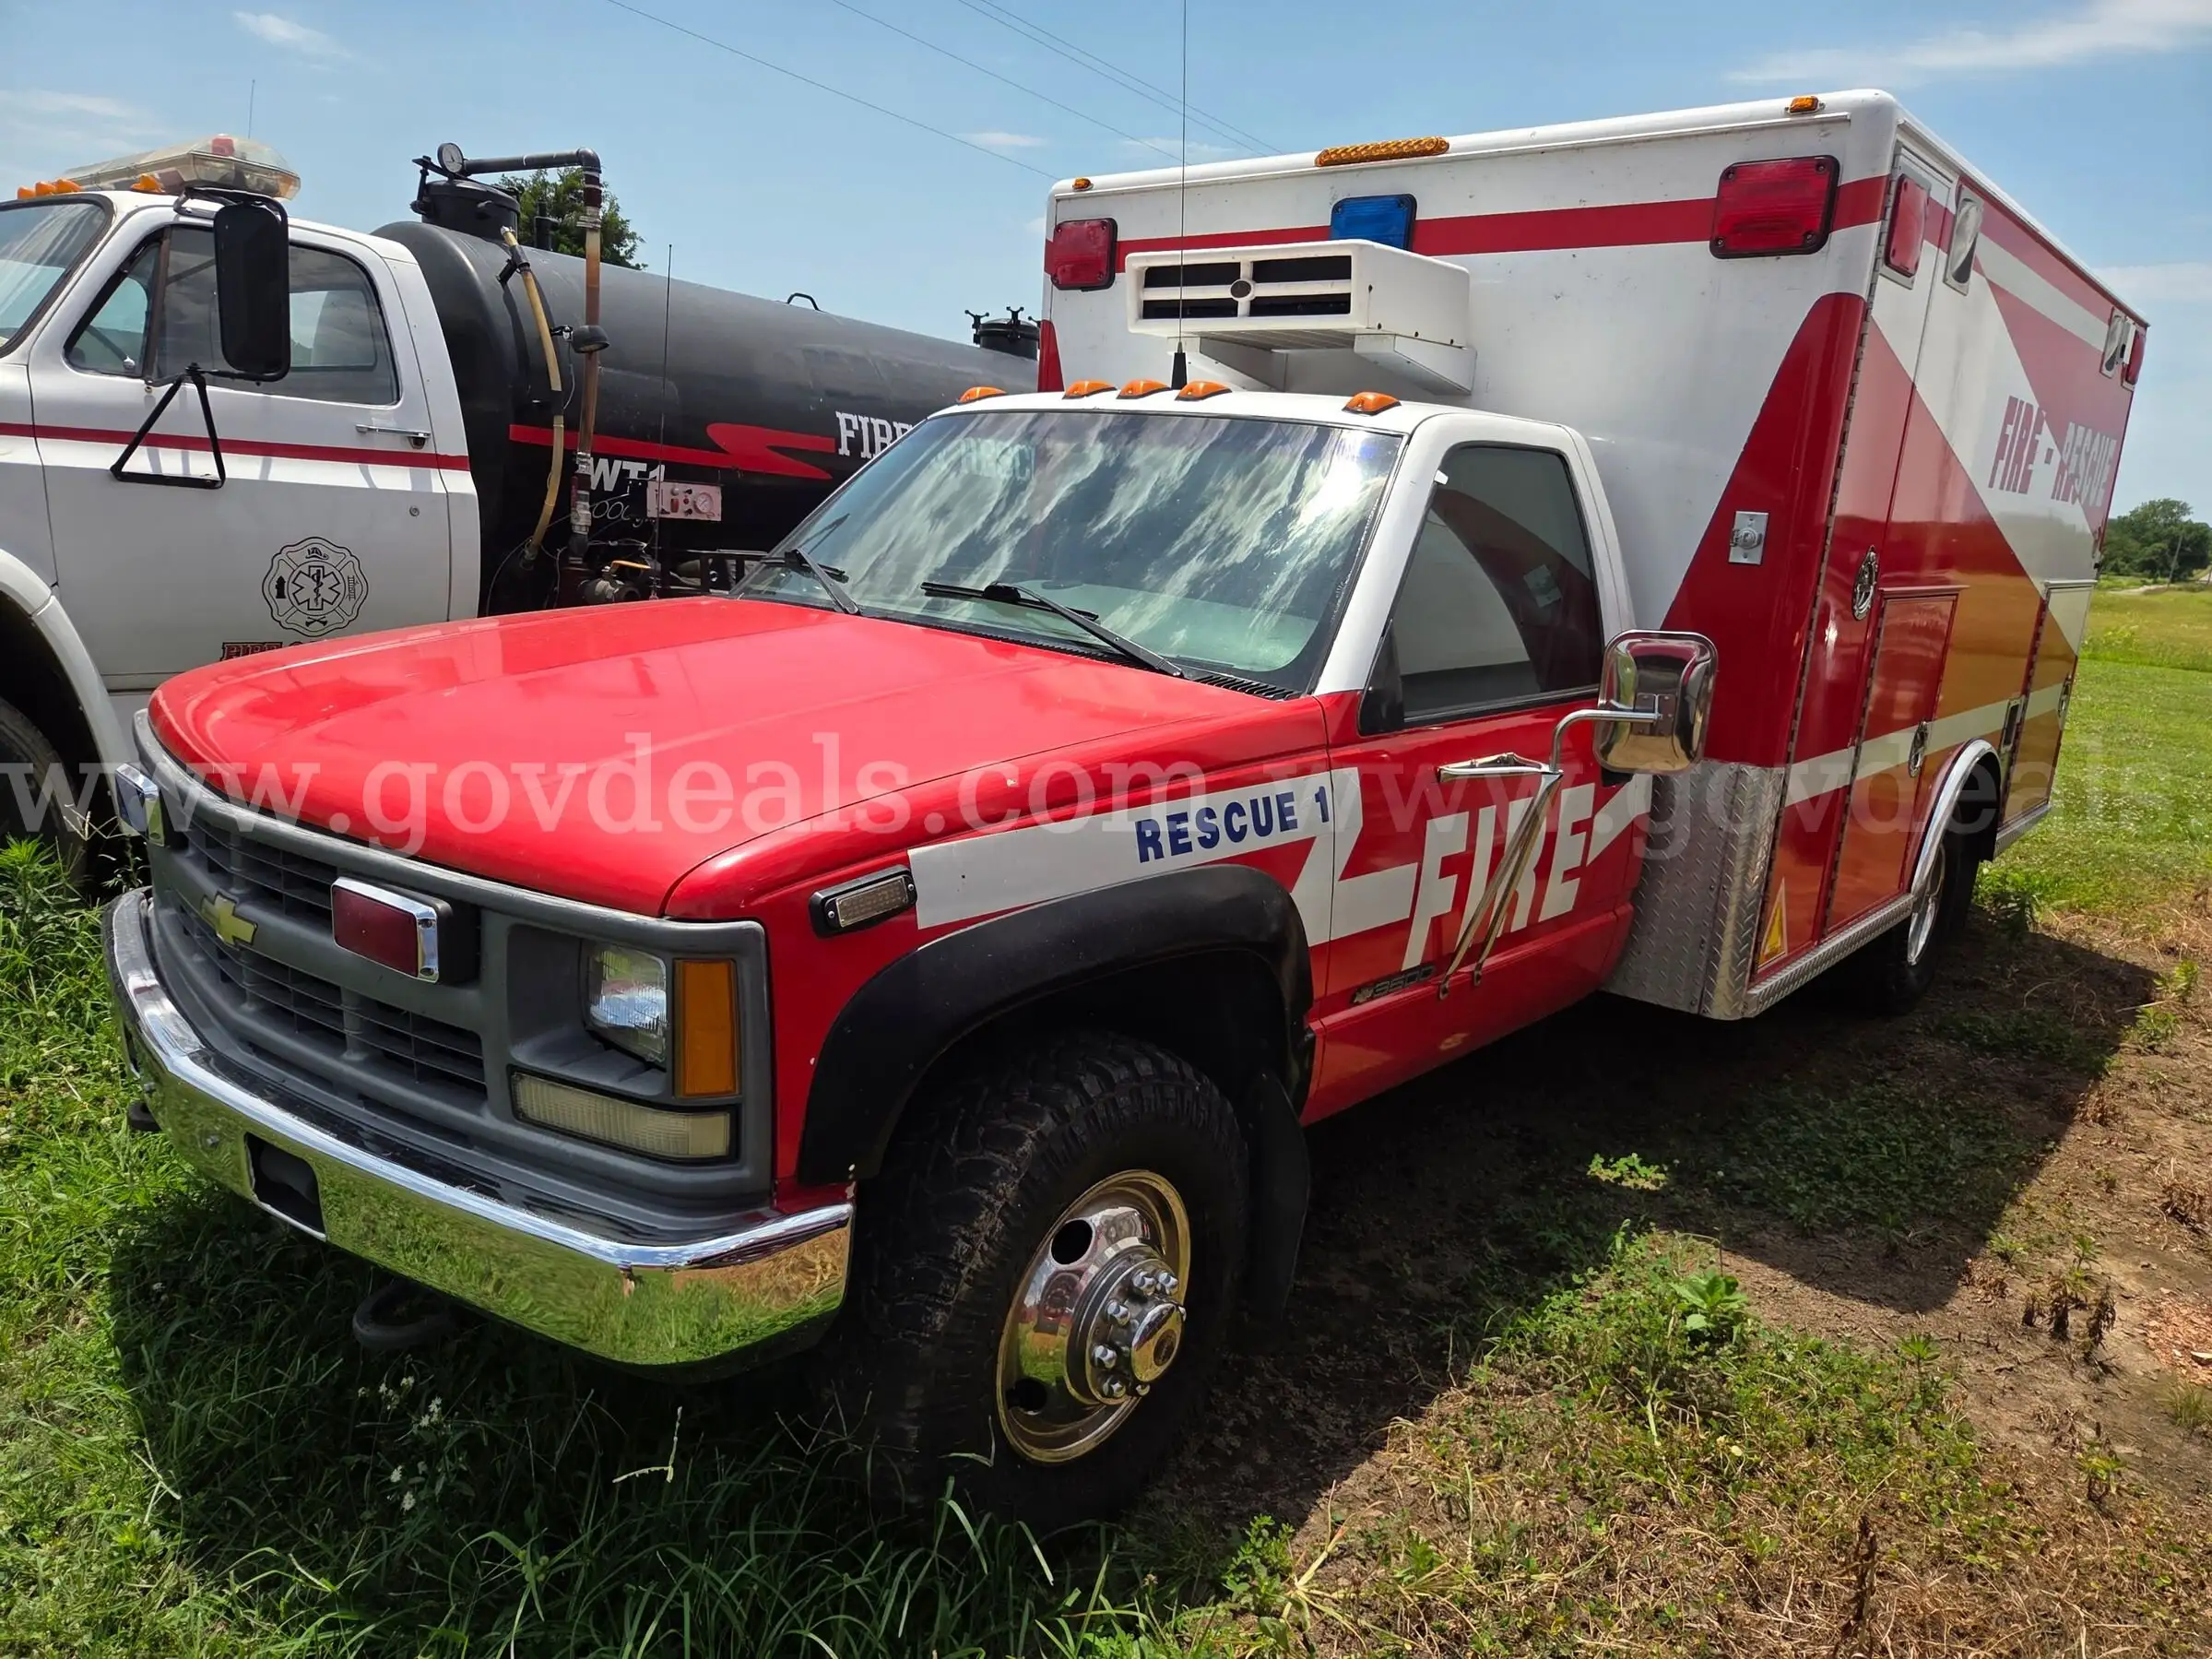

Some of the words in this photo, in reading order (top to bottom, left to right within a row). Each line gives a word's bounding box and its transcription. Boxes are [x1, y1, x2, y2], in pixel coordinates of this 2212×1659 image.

[835, 410, 913, 459] FIR
[1988, 395, 2047, 494] FIRE
[2050, 421, 2117, 507] RESCUE
[1135, 791, 1298, 863] RESCUE
[1314, 785, 1330, 824] 1
[1402, 782, 1595, 971] FIRE
